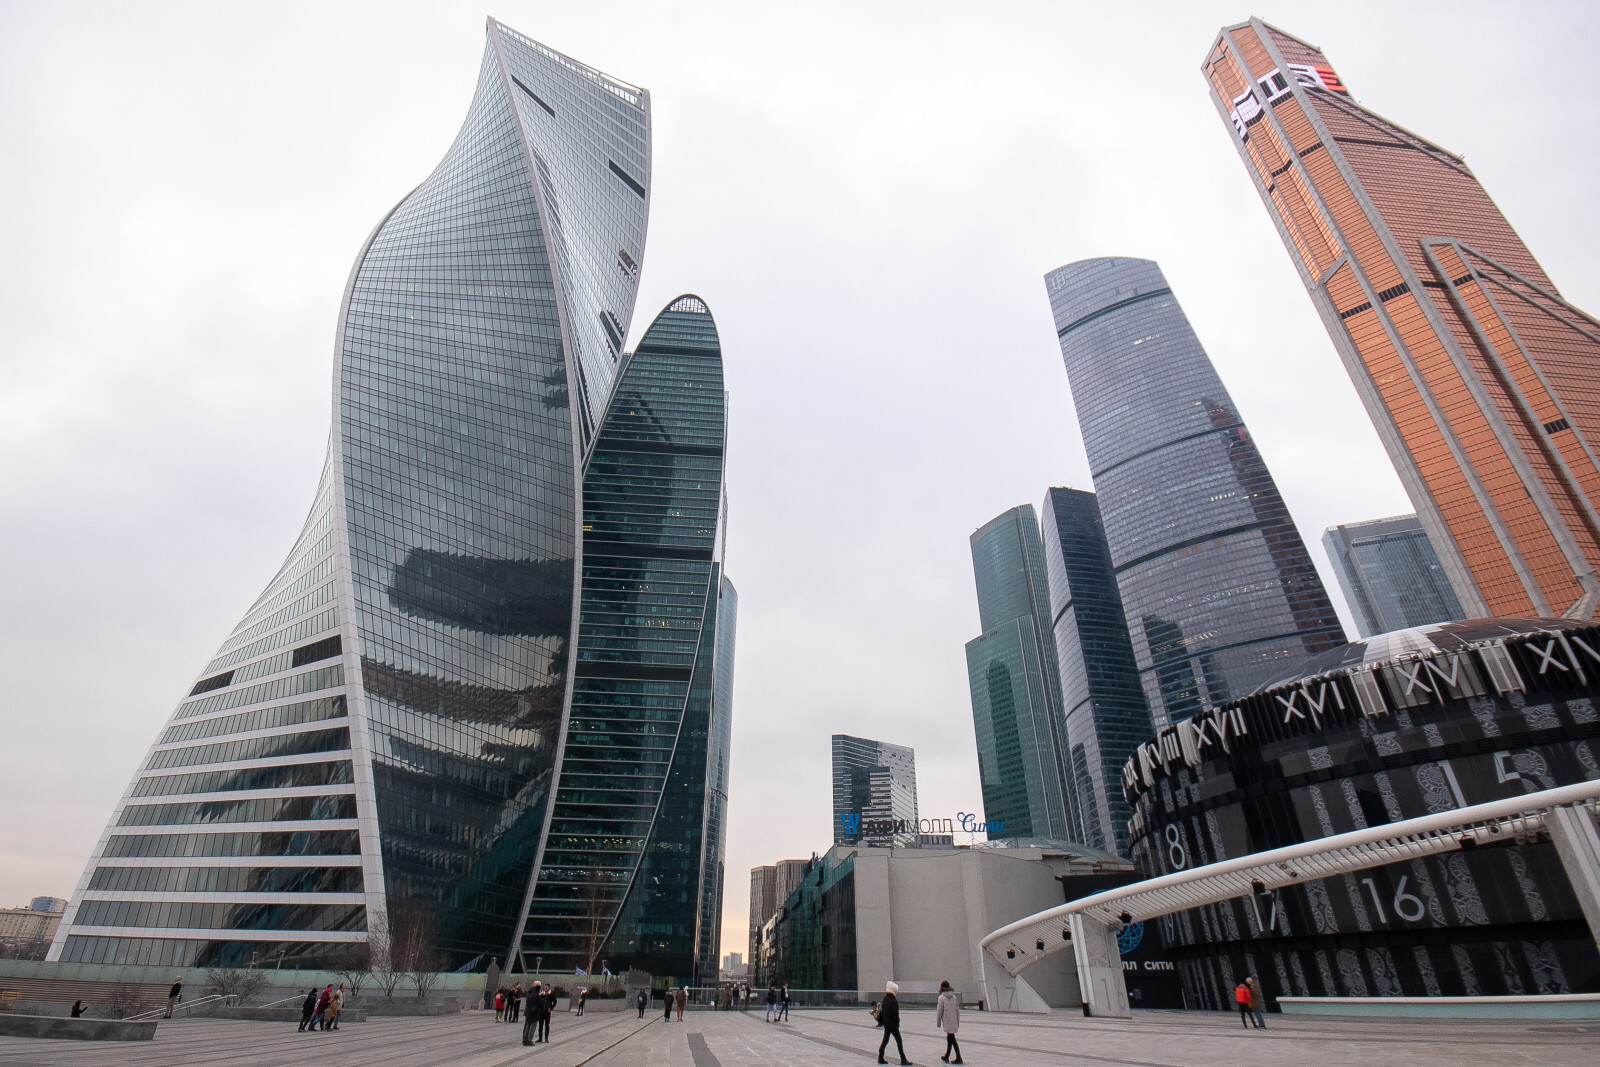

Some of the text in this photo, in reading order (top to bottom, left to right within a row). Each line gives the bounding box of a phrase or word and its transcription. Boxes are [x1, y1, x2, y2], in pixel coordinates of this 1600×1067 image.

[1394, 655, 1459, 696] XV
[1275, 680, 1345, 724] XVI
[1191, 707, 1248, 749] XVII
[1362, 874, 1425, 925] 16
[1144, 960, 1175, 971] СИТИ
[993, 986, 1016, 1010] 17
